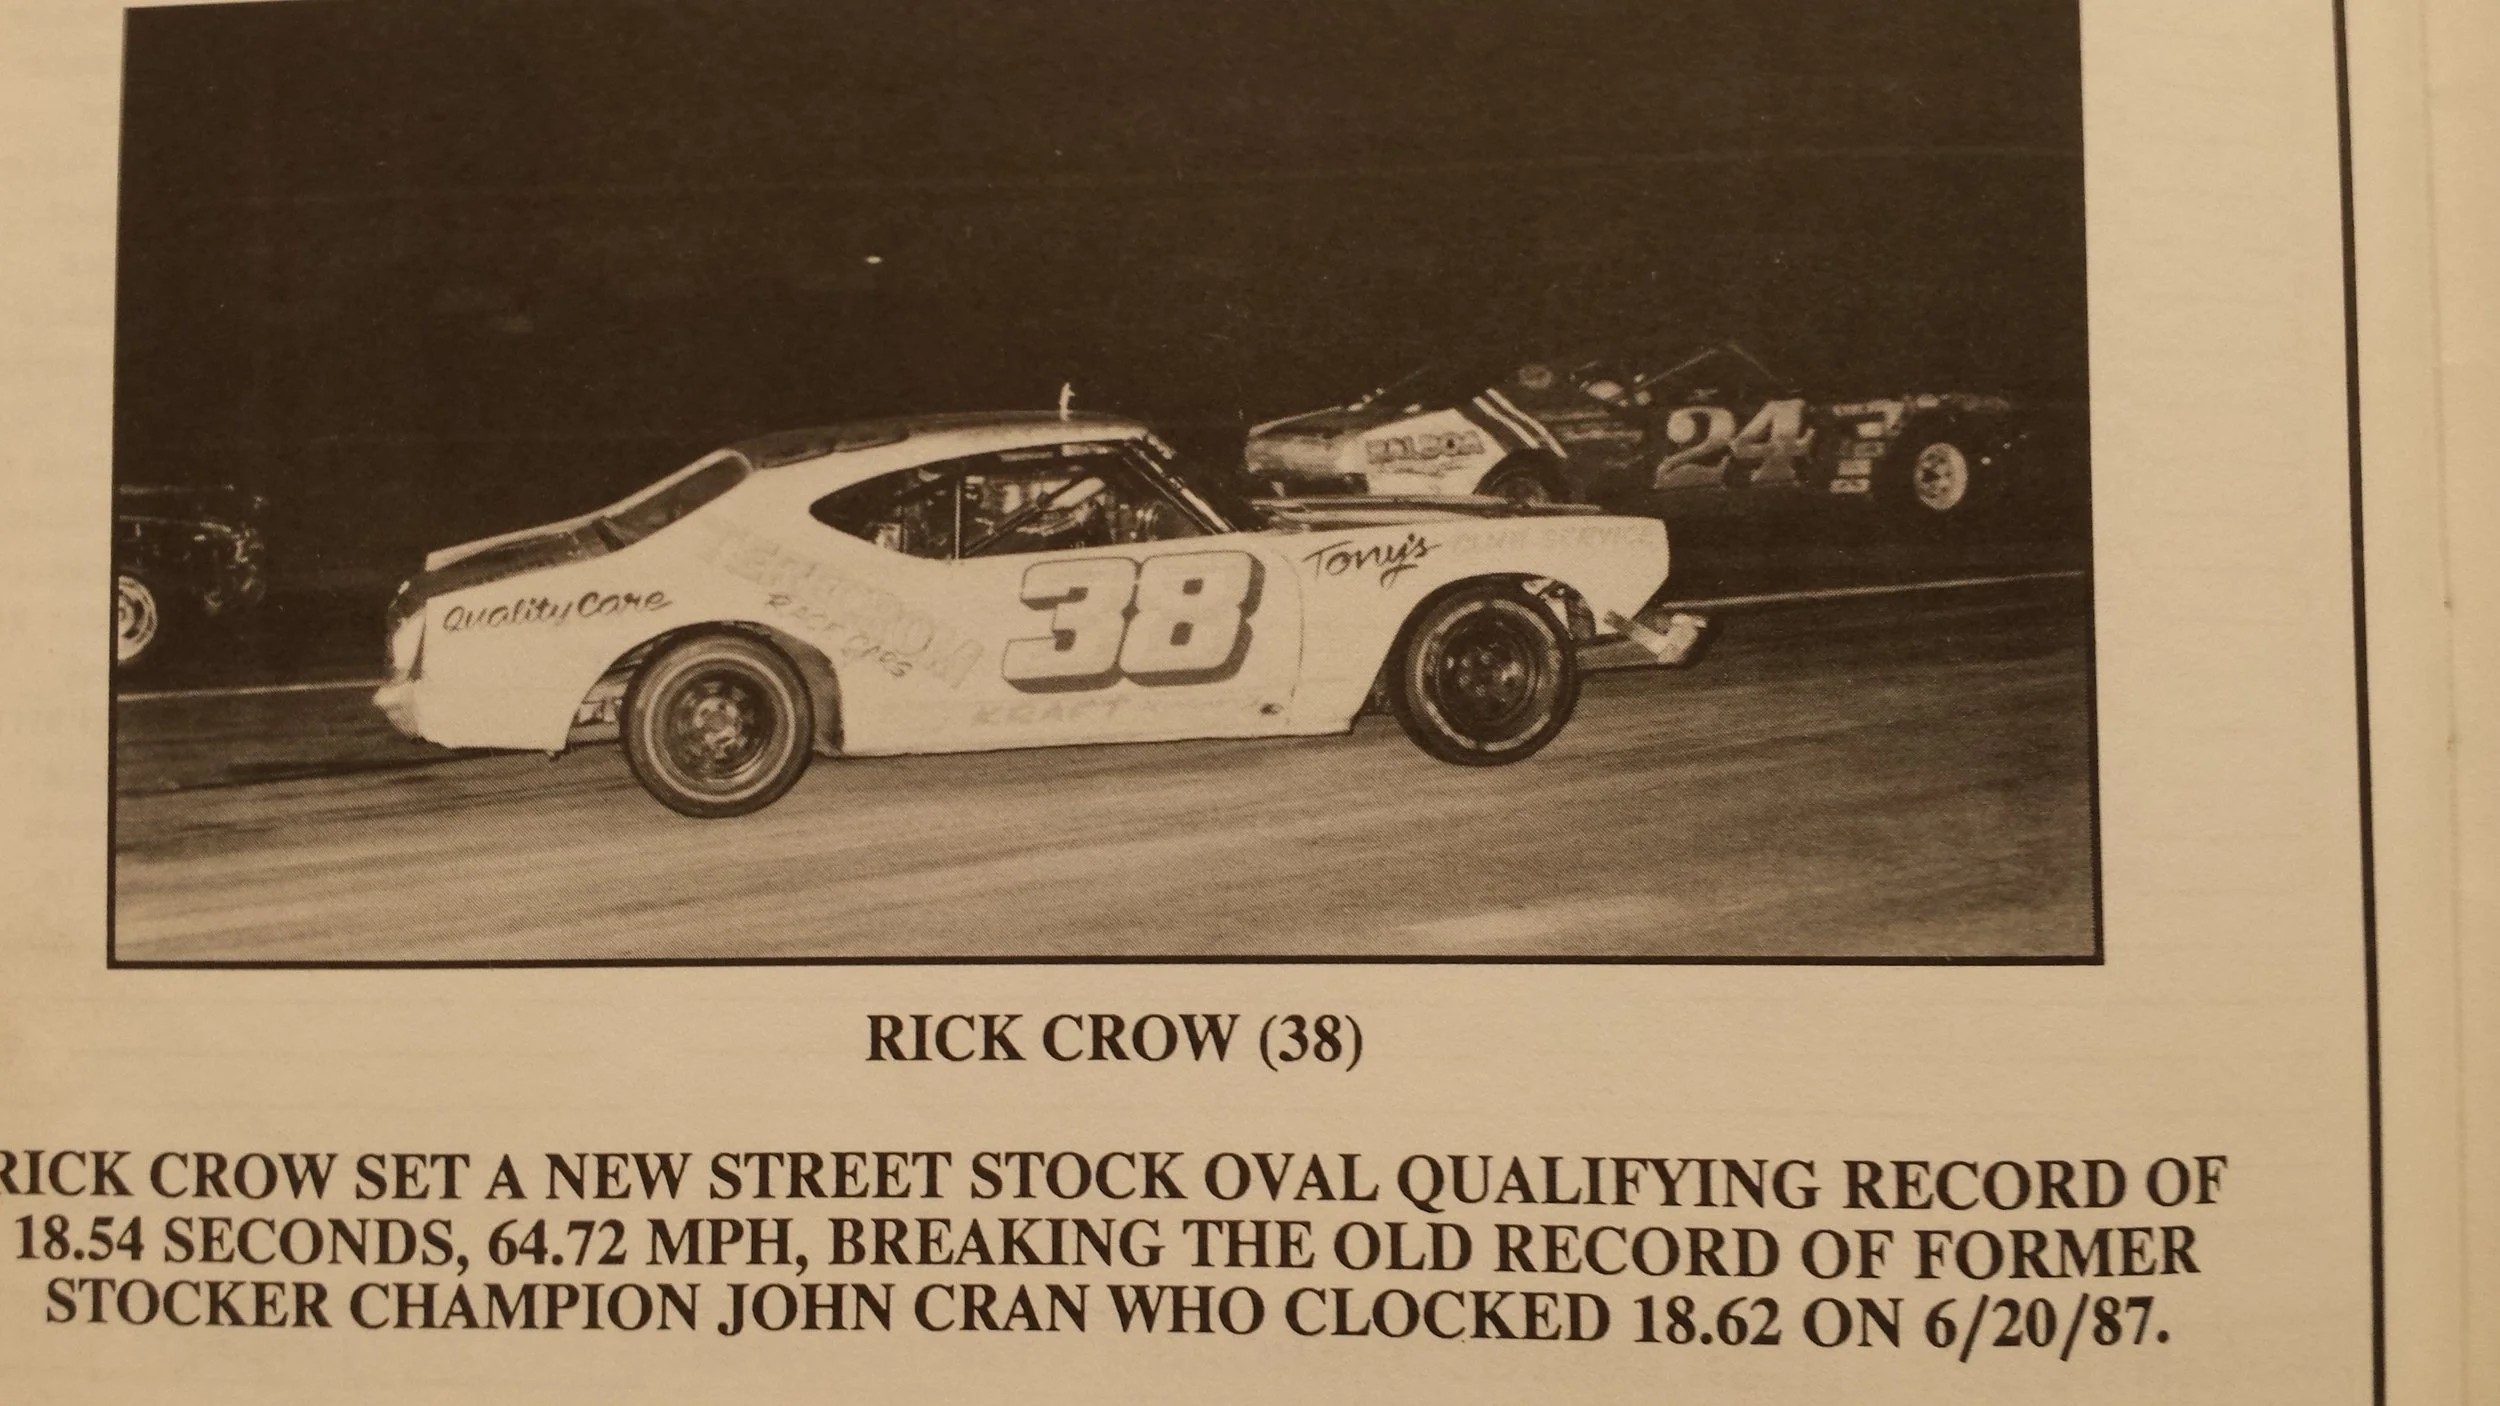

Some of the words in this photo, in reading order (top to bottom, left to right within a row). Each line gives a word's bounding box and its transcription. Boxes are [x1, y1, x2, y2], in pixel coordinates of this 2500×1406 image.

[1653, 398, 1815, 490] 24
[1302, 532, 1442, 590] Tony's
[442, 596, 572, 632] Quality
[1000, 550, 1265, 694] 38
[865, 1014, 1026, 1062] RICK
[1042, 1014, 1241, 1062] CROW
[1259, 1014, 1363, 1073] (38)
[150, 1152, 338, 1200] CROW
[355, 1153, 470, 1201] SET
[485, 1153, 527, 1200] A
[545, 1152, 692, 1200] NEW
[709, 1151, 952, 1200] STREET
[971, 1151, 1188, 1200] STOCK
[1204, 1152, 1380, 1202] OVAL
[1397, 1154, 1821, 1214] QUALIFYING
[1842, 1159, 2127, 1211] RECORD
[2146, 1155, 2228, 1207] OF
[15, 1214, 145, 1261] 18.54
[164, 1216, 469, 1277] SECONDS,
[488, 1218, 627, 1266] 64.72
[646, 1218, 808, 1277] MPH,
[828, 1217, 1165, 1268] BREAKING
[1182, 1219, 1315, 1269] THE
[1333, 1221, 1472, 1271] OLD
[1493, 1223, 1780, 1278] RECORD
[1801, 1229, 1894, 1280] OF
[1913, 1225, 2201, 1281] FORMER
[46, 1277, 332, 1328] STOCKER
[349, 1282, 701, 1331] CHAMPION
[717, 1283, 895, 1337] JOHN
[914, 1283, 1090, 1333] CRAN
[1106, 1284, 1265, 1335] WHO
[1285, 1287, 1610, 1342] CLOCKED
[1634, 1295, 1782, 1346] 18.62
[1803, 1297, 1904, 1348] ON
[1925, 1292, 2170, 1364] 6/20/87.
